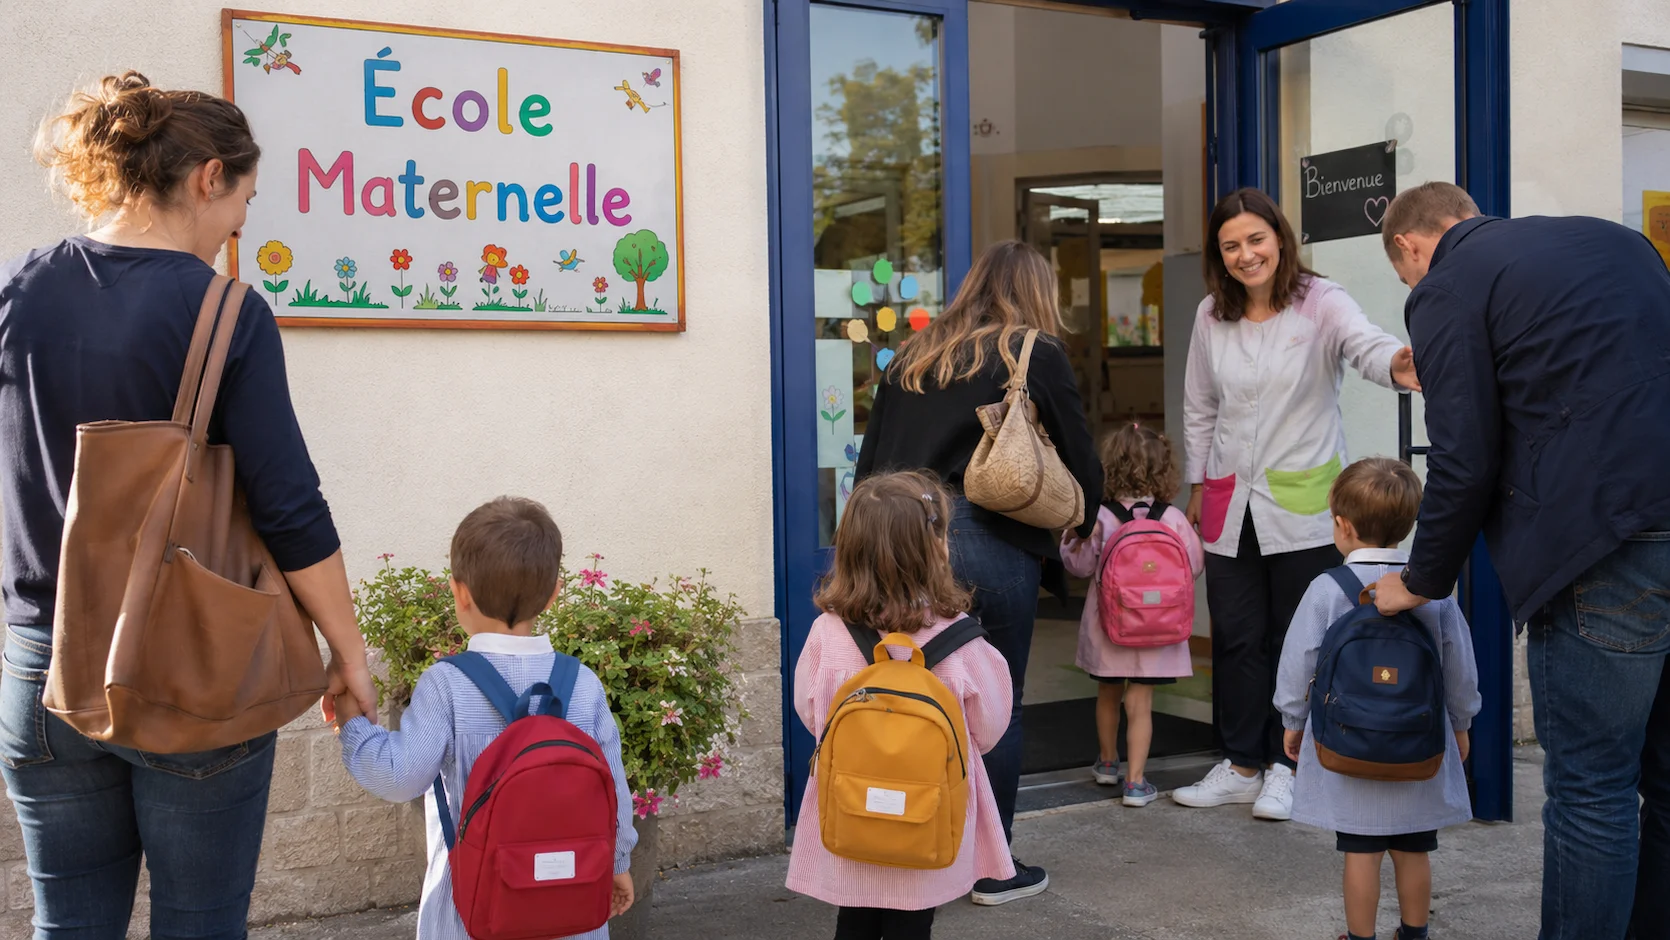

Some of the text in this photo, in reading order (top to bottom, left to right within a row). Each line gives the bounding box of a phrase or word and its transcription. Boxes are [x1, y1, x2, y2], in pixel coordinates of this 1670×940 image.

[364, 46, 553, 137] École
[298, 148, 632, 227] Maternelle
[1304, 165, 1384, 198] Bienvenue
